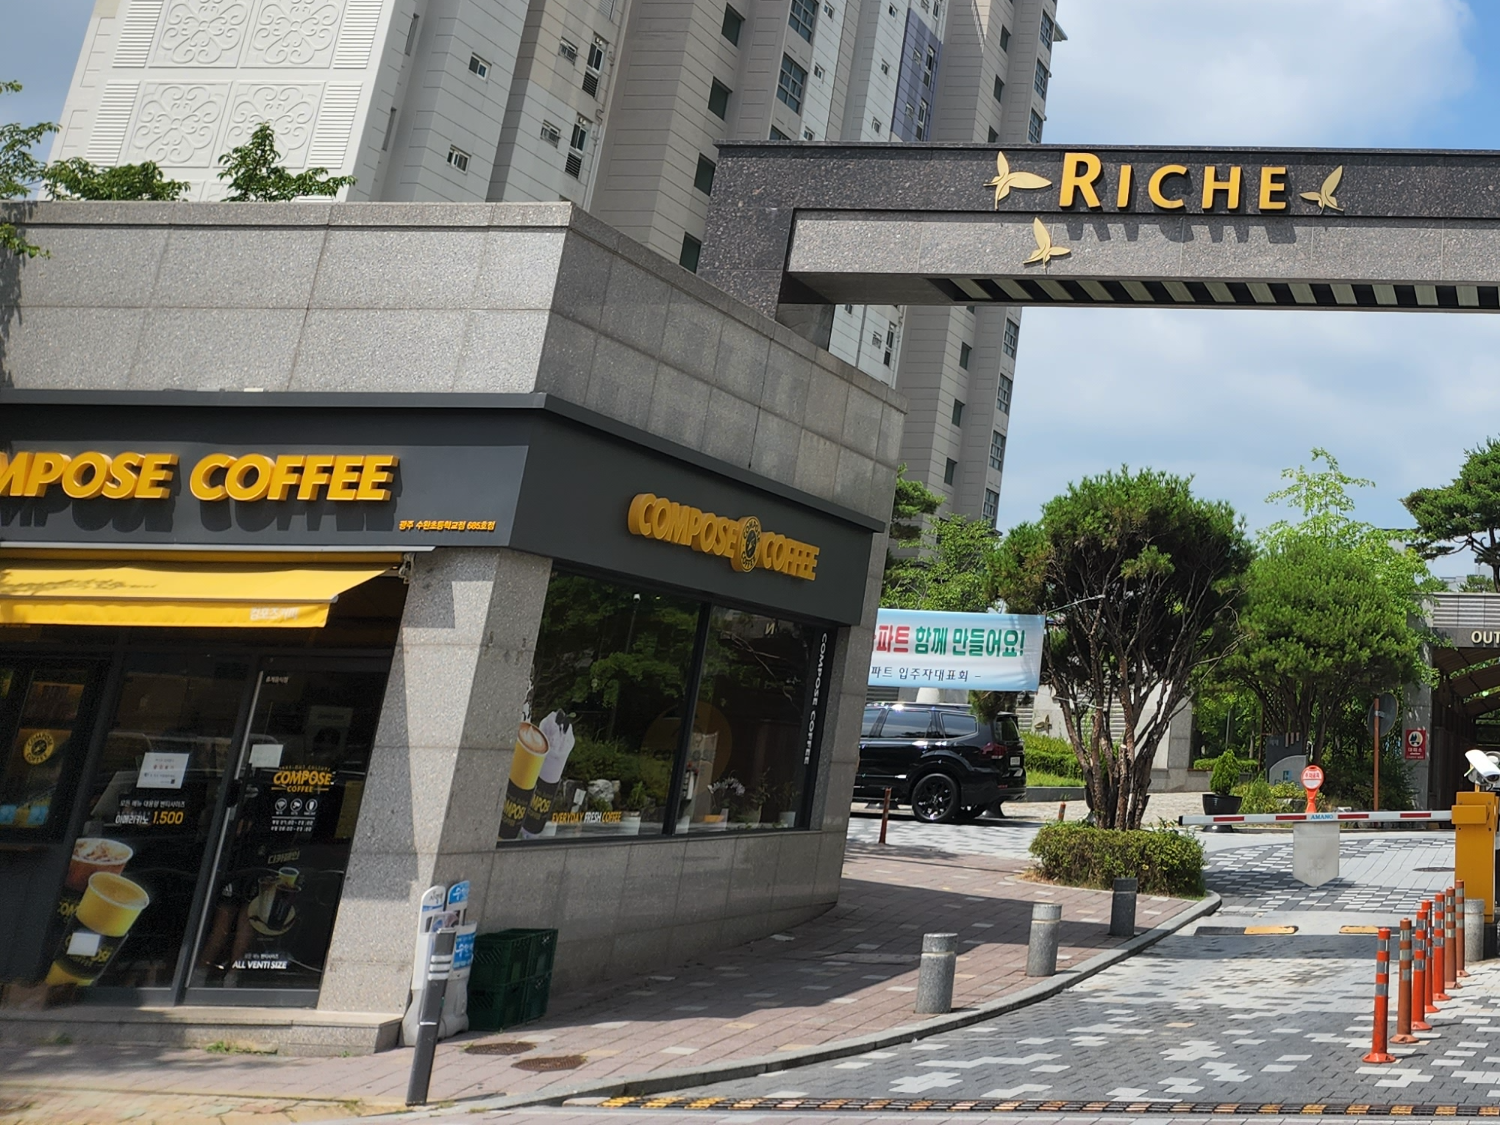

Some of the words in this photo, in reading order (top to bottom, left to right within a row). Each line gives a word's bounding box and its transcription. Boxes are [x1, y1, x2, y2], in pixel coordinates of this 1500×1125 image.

[1058, 152, 1287, 210] RICHE
[190, 454, 399, 502] COFFEE
[629, 493, 740, 559] COMPOSE
[757, 531, 820, 581] COFFEE
[873, 625, 910, 653] 파트
[914, 626, 948, 655] 함께
[952, 627, 1025, 657] 만들어요!
[812, 633, 827, 706] COMPOSE
[899, 667, 969, 682] 입주자대표회
[804, 710, 816, 765] COFFEE
[273, 770, 332, 785] COMPOSE
[552, 812, 583, 823] EVERYDAY
[584, 811, 601, 823] FRESH
[602, 811, 621, 823] COFFEE
[232, 960, 246, 969] ALL
[247, 960, 270, 969] VENTI
[270, 960, 287, 969] SIZE
